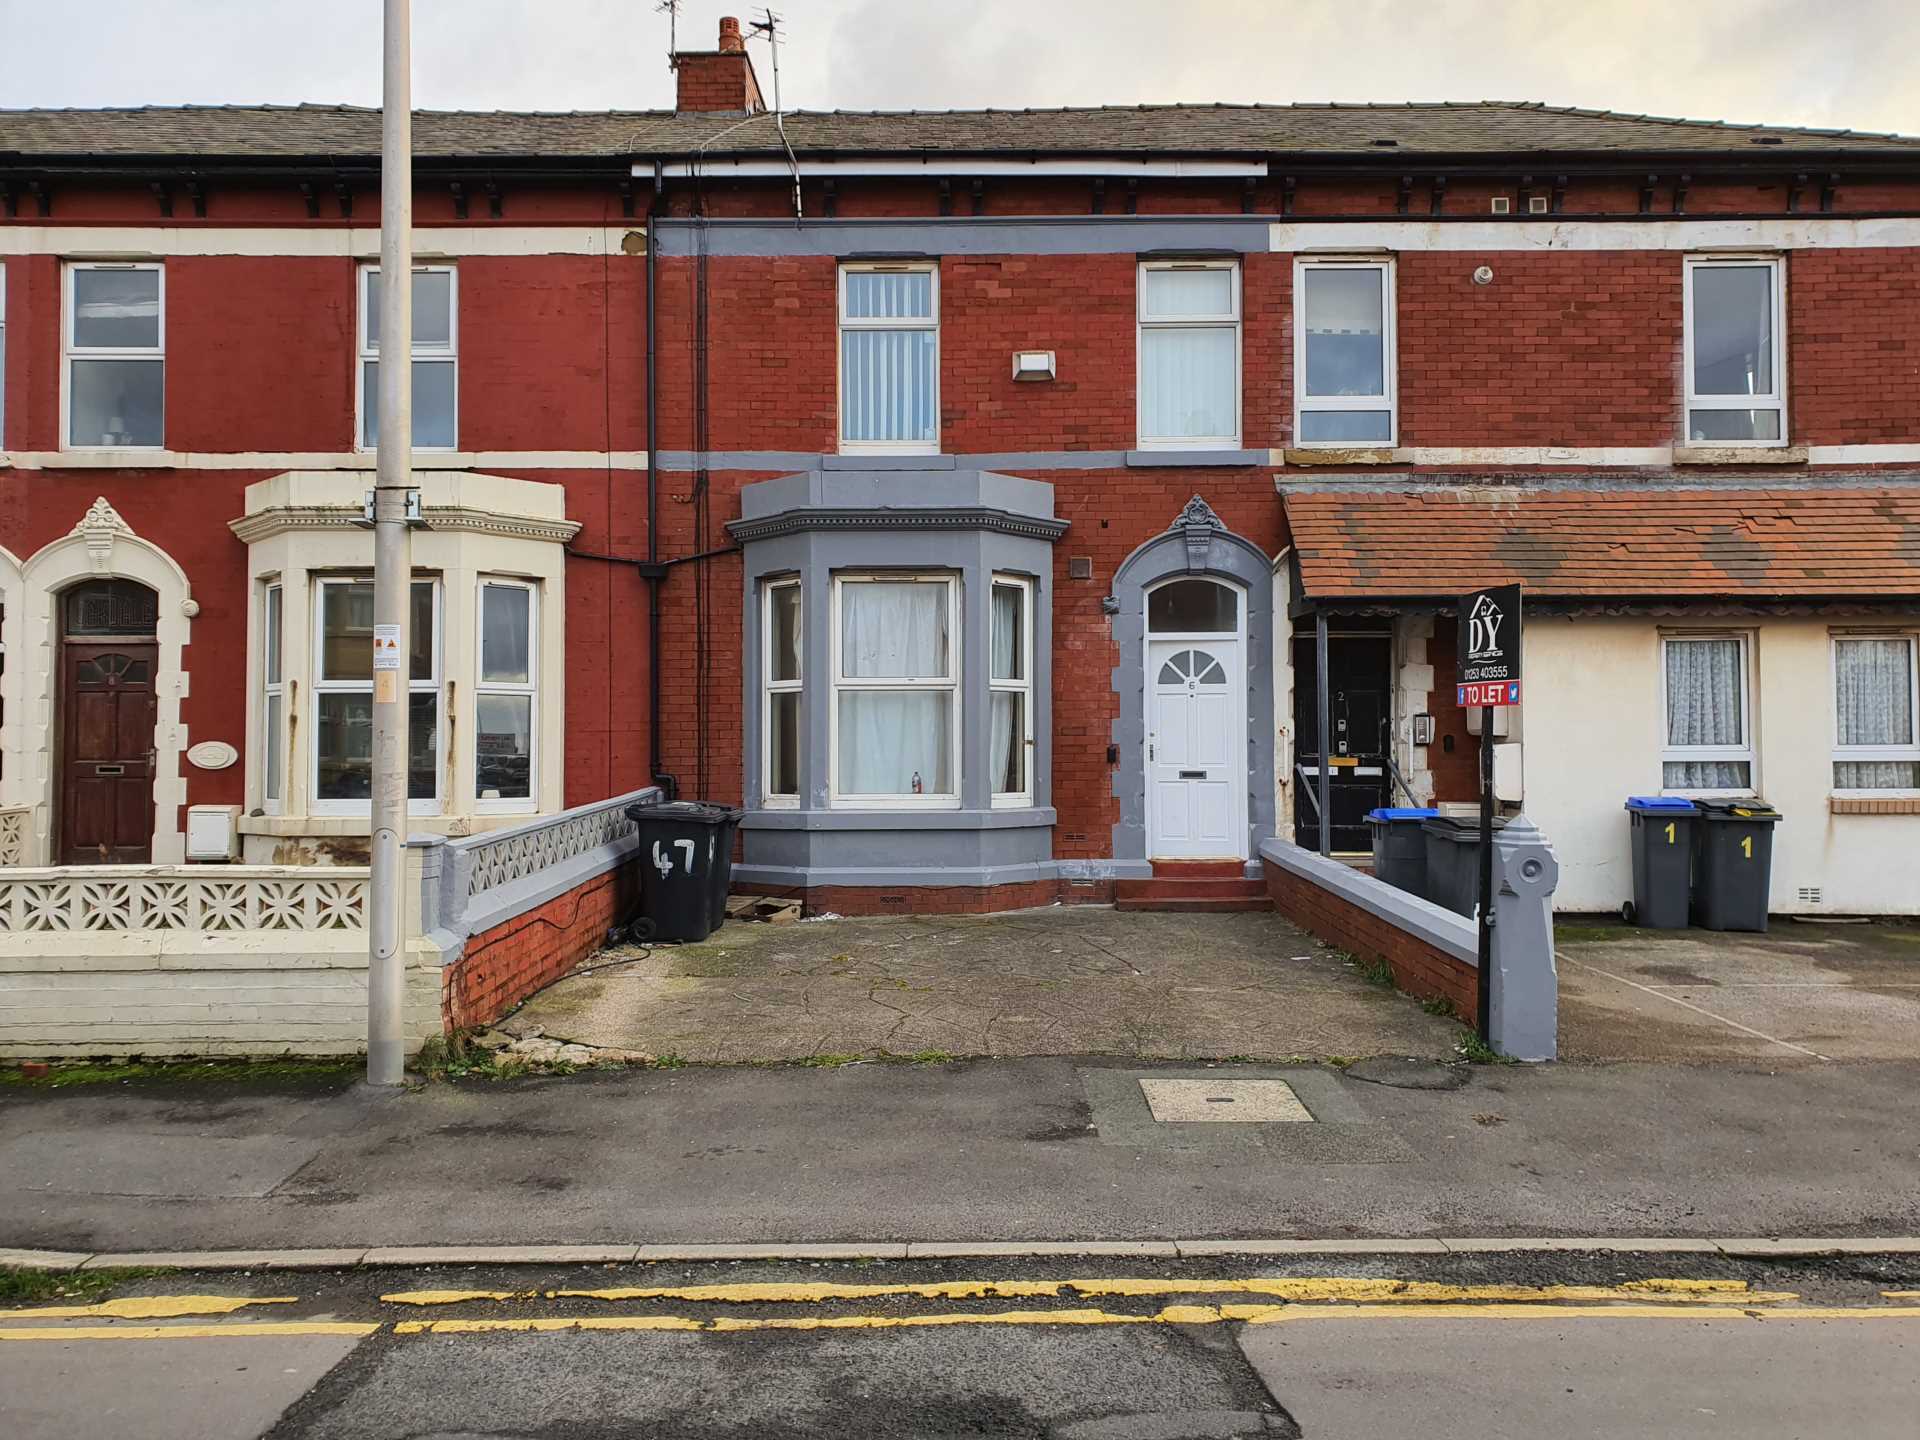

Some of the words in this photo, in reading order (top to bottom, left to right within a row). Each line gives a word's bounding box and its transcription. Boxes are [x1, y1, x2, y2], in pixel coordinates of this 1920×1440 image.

[1469, 615, 1503, 653] DY
[1465, 668, 1479, 680] 01253
[1481, 666, 1508, 679] 403555
[1337, 691, 1345, 701] 2
[1467, 686, 1479, 704] TO
[1482, 685, 1504, 703] LET
[1665, 822, 1675, 844] 1
[1741, 836, 1752, 858] 1
[653, 839, 695, 880] 47
